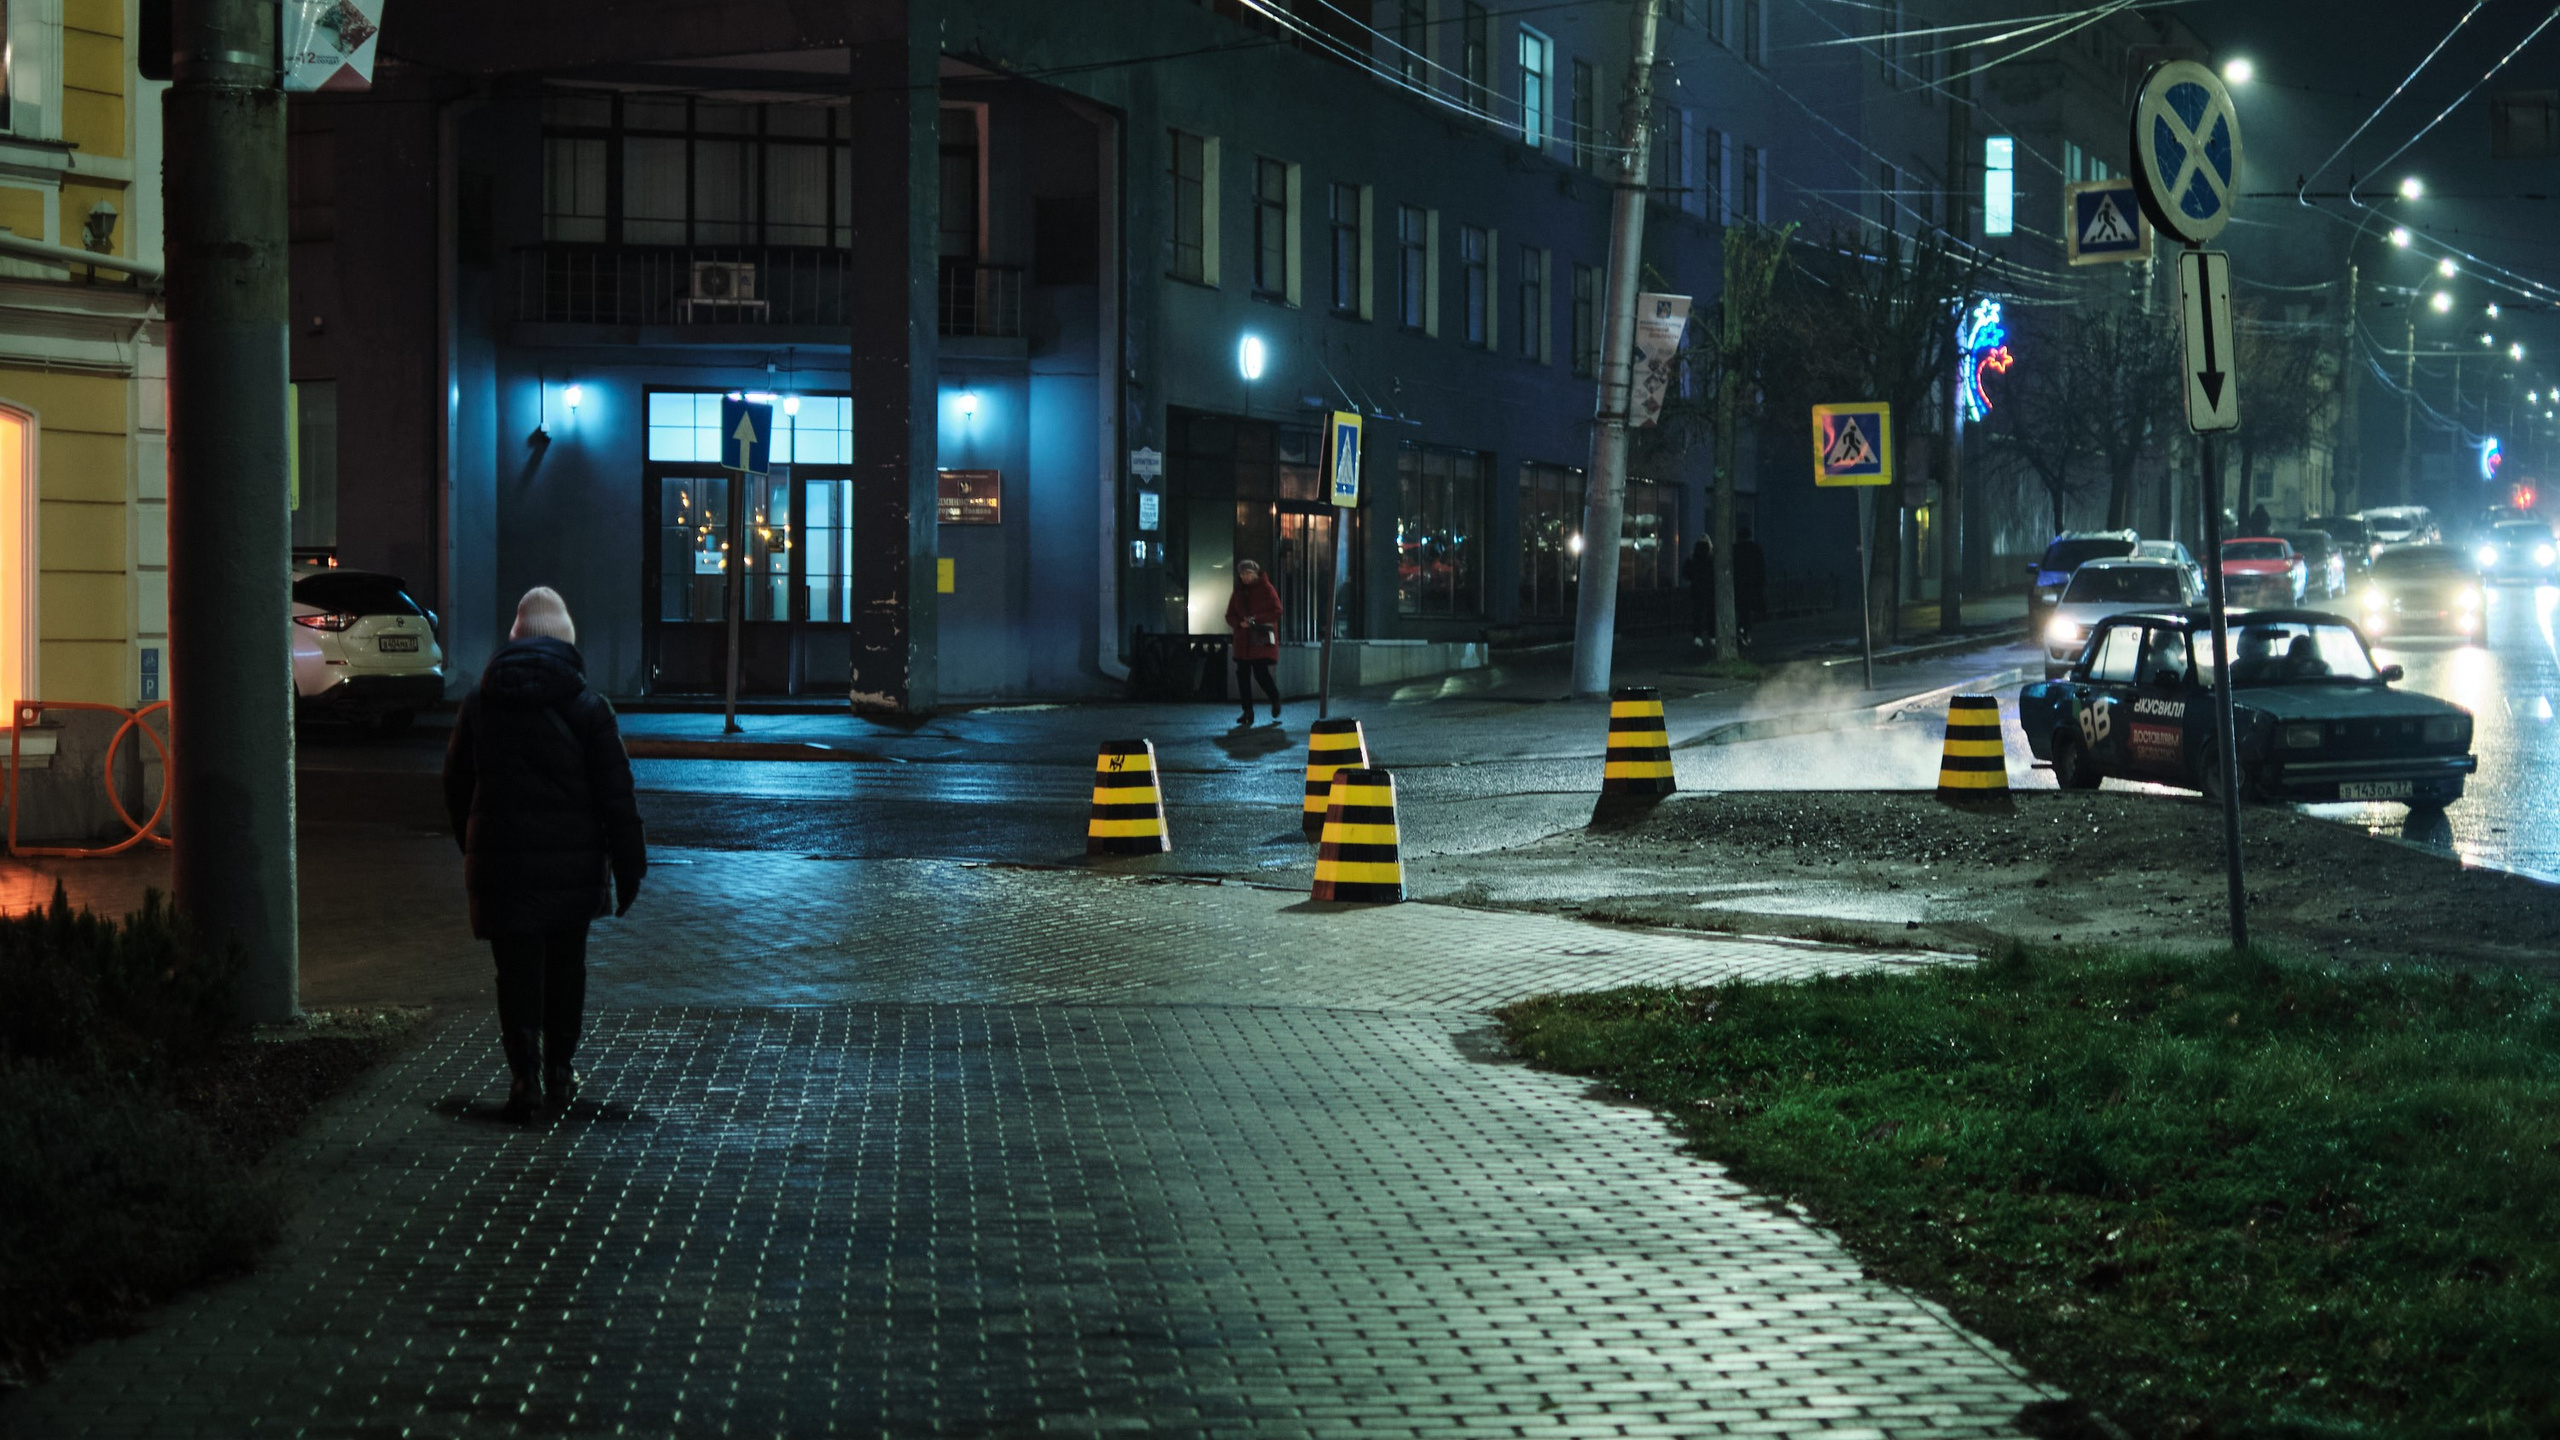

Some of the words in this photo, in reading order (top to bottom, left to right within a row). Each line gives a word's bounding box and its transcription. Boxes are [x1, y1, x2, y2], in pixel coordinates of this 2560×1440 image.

[299, 52, 316, 64] 12
[939, 498, 997, 507] ДМИНИСТРАЦИЯ
[2134, 697, 2185, 718] ВКУСВИЛЛ
[2133, 729, 2179, 747] ДОСТАВЛЯЕМ
